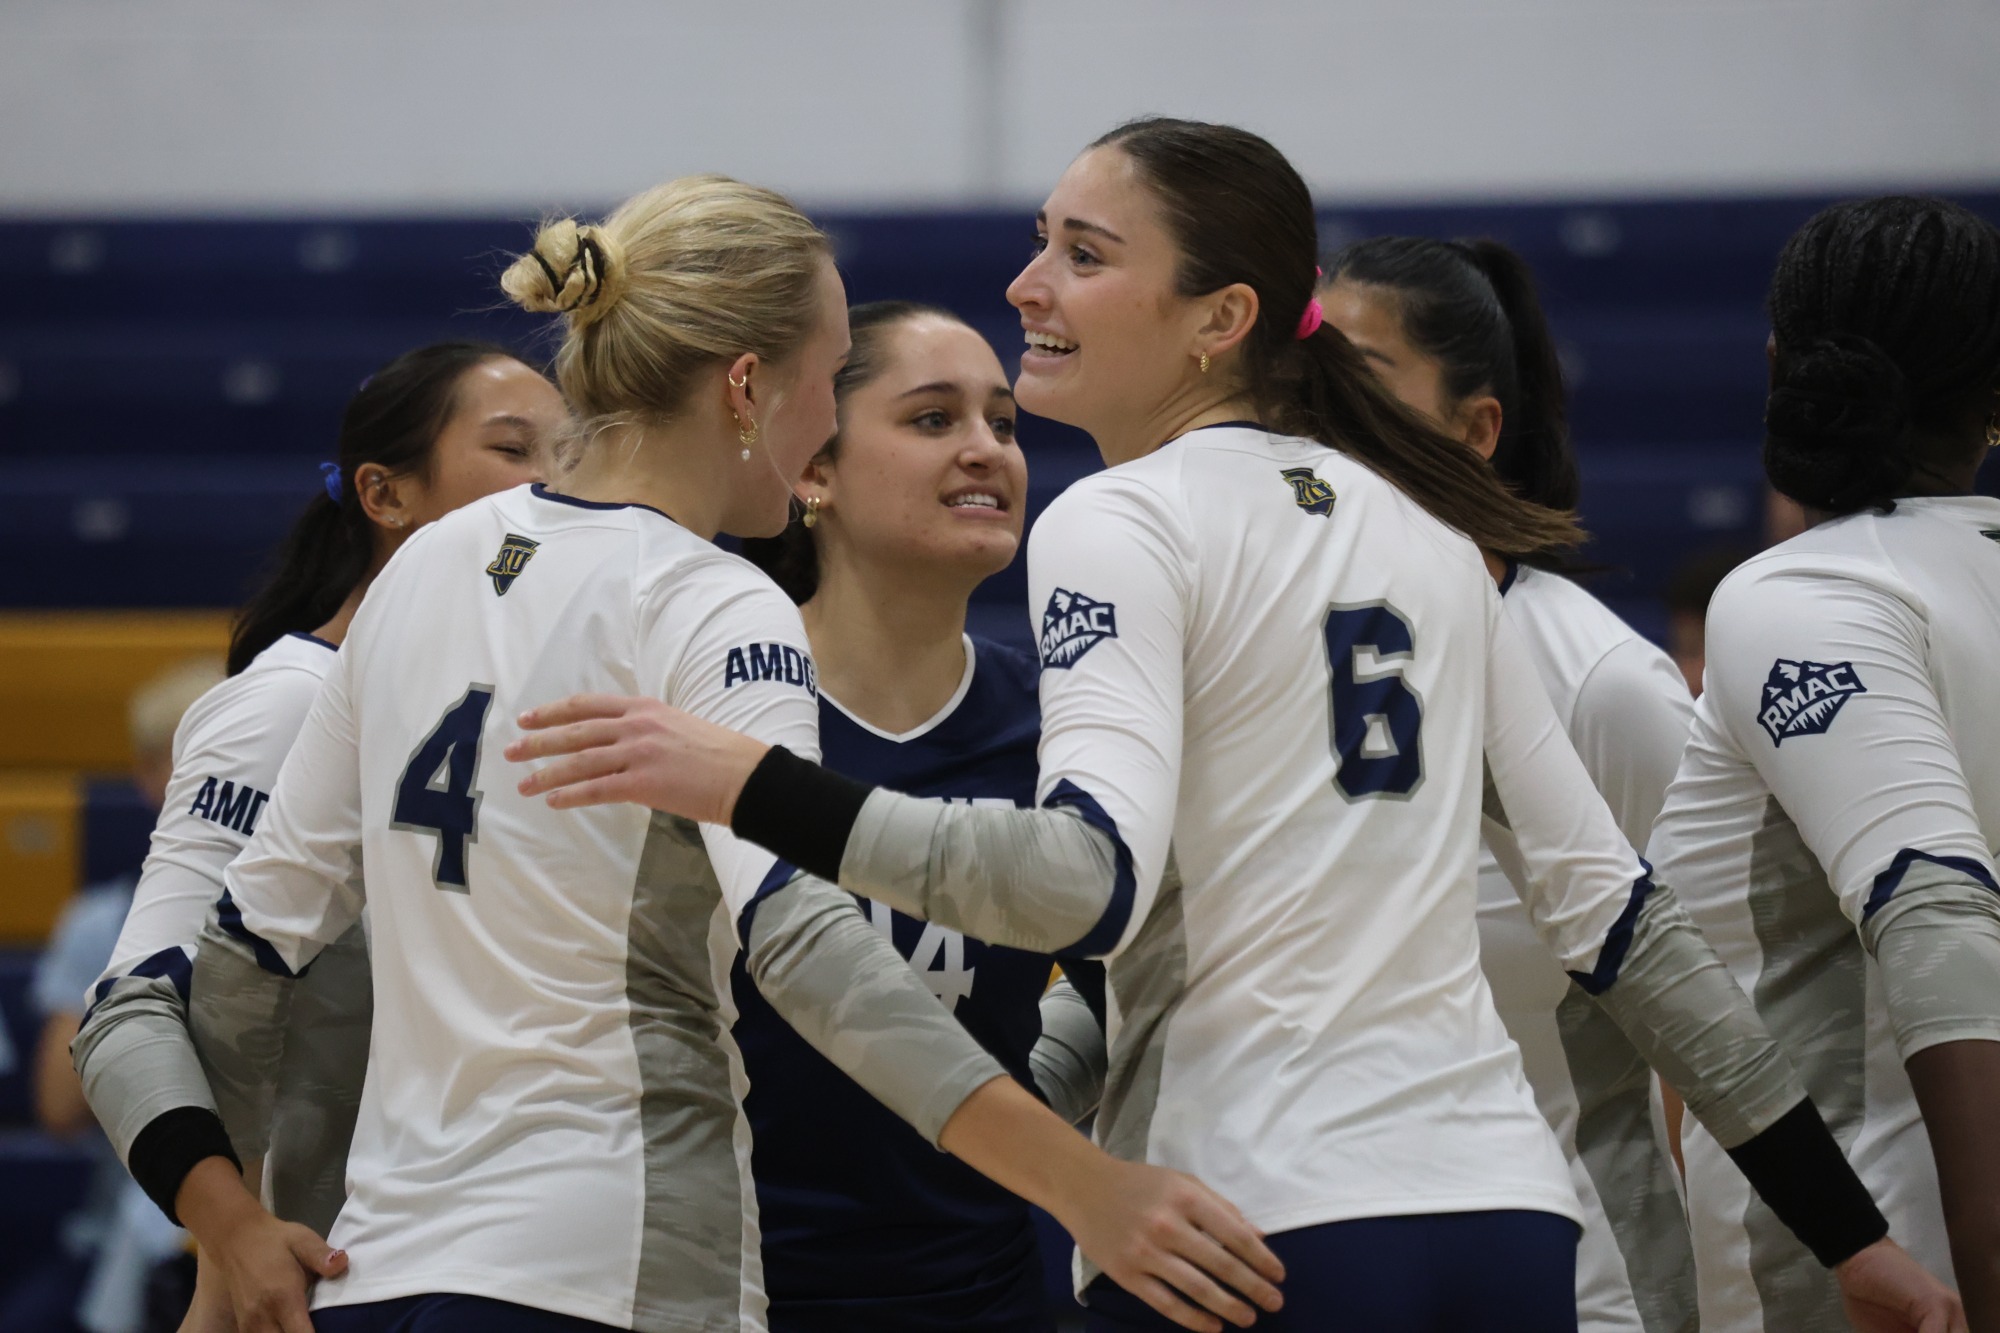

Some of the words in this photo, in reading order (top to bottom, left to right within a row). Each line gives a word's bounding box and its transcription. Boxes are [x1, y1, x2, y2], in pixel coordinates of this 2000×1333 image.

[388, 681, 496, 896] 4
[1320, 598, 1426, 805] 6
[1761, 666, 1859, 740] RMAC
